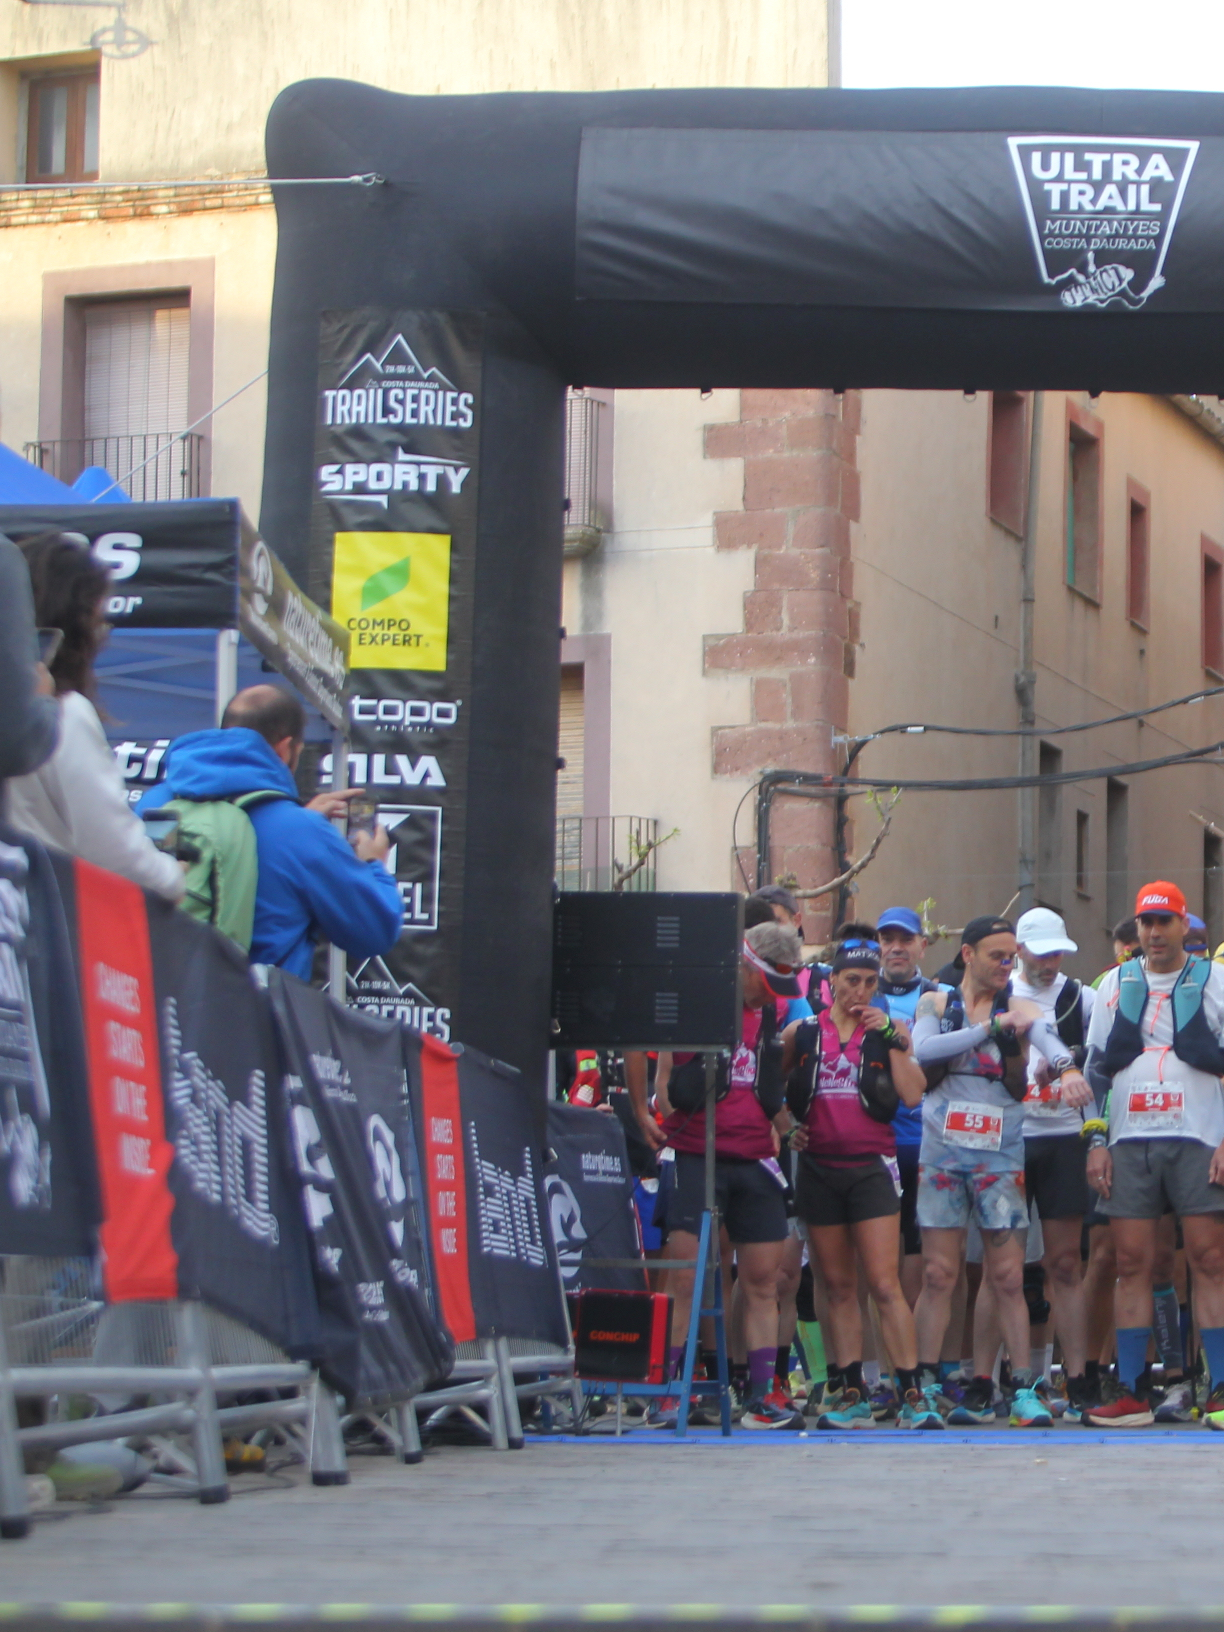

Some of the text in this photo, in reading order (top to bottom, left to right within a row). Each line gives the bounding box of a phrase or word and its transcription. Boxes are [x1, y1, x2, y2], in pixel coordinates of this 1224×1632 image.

[1031, 151, 1174, 181] ULTRA
[1043, 182, 1162, 211] TRAIL
[1043, 219, 1160, 235] MUNTANYES
[1044, 237, 1157, 250] COSTA DAURADA
[325, 388, 473, 428] TRAILSERIES
[320, 463, 471, 494] SPORTY
[347, 617, 411, 632] COMPO
[358, 633, 424, 647] EXPERT
[352, 695, 459, 725] topo
[375, 724, 434, 733] athletic
[357, 995, 415, 1005] COSTA DAURADA
[1145, 1093, 1165, 1107] 54
[964, 1113, 984, 1129] 55
